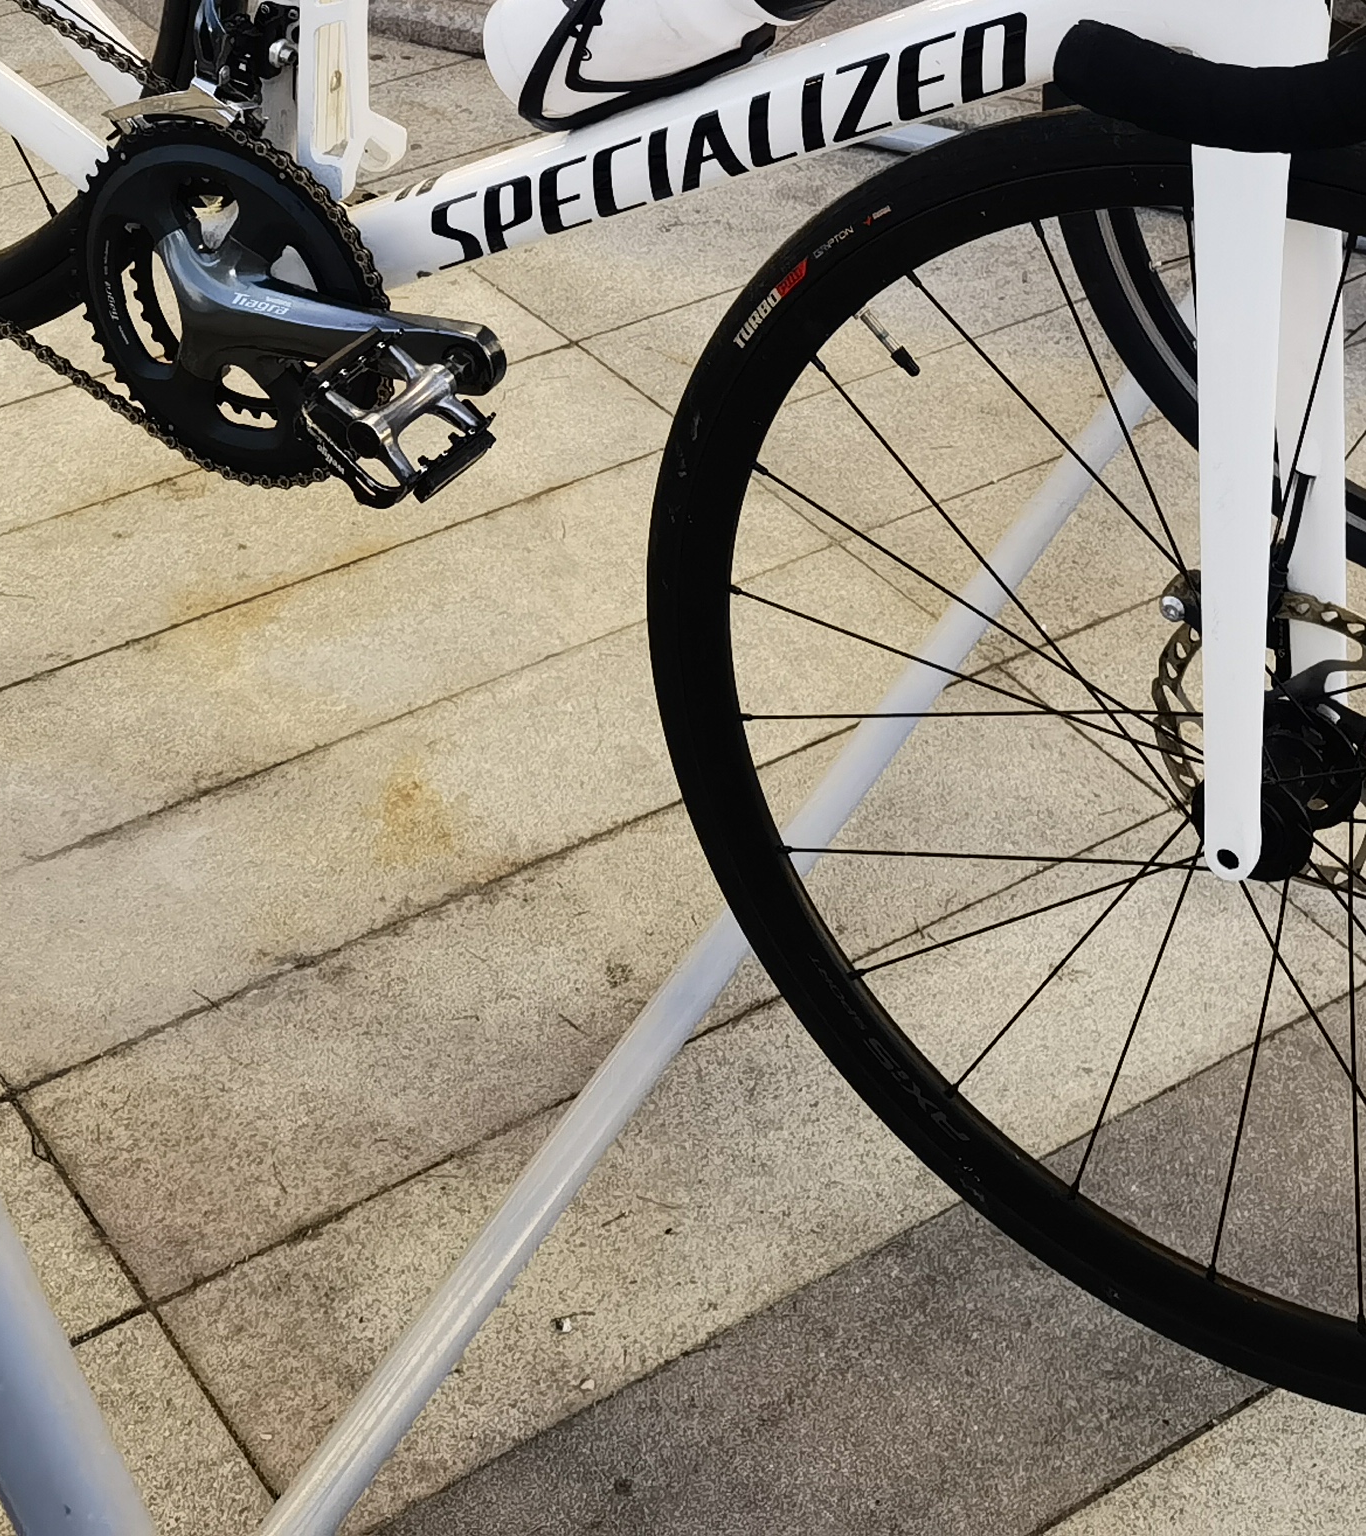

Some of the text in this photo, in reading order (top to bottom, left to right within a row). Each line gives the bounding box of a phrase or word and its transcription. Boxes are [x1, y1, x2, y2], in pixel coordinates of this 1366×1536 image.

[431, 12, 1028, 271] SPECIALIZED
[231, 292, 290, 315] Tiagra
[733, 287, 783, 350] TURBO
